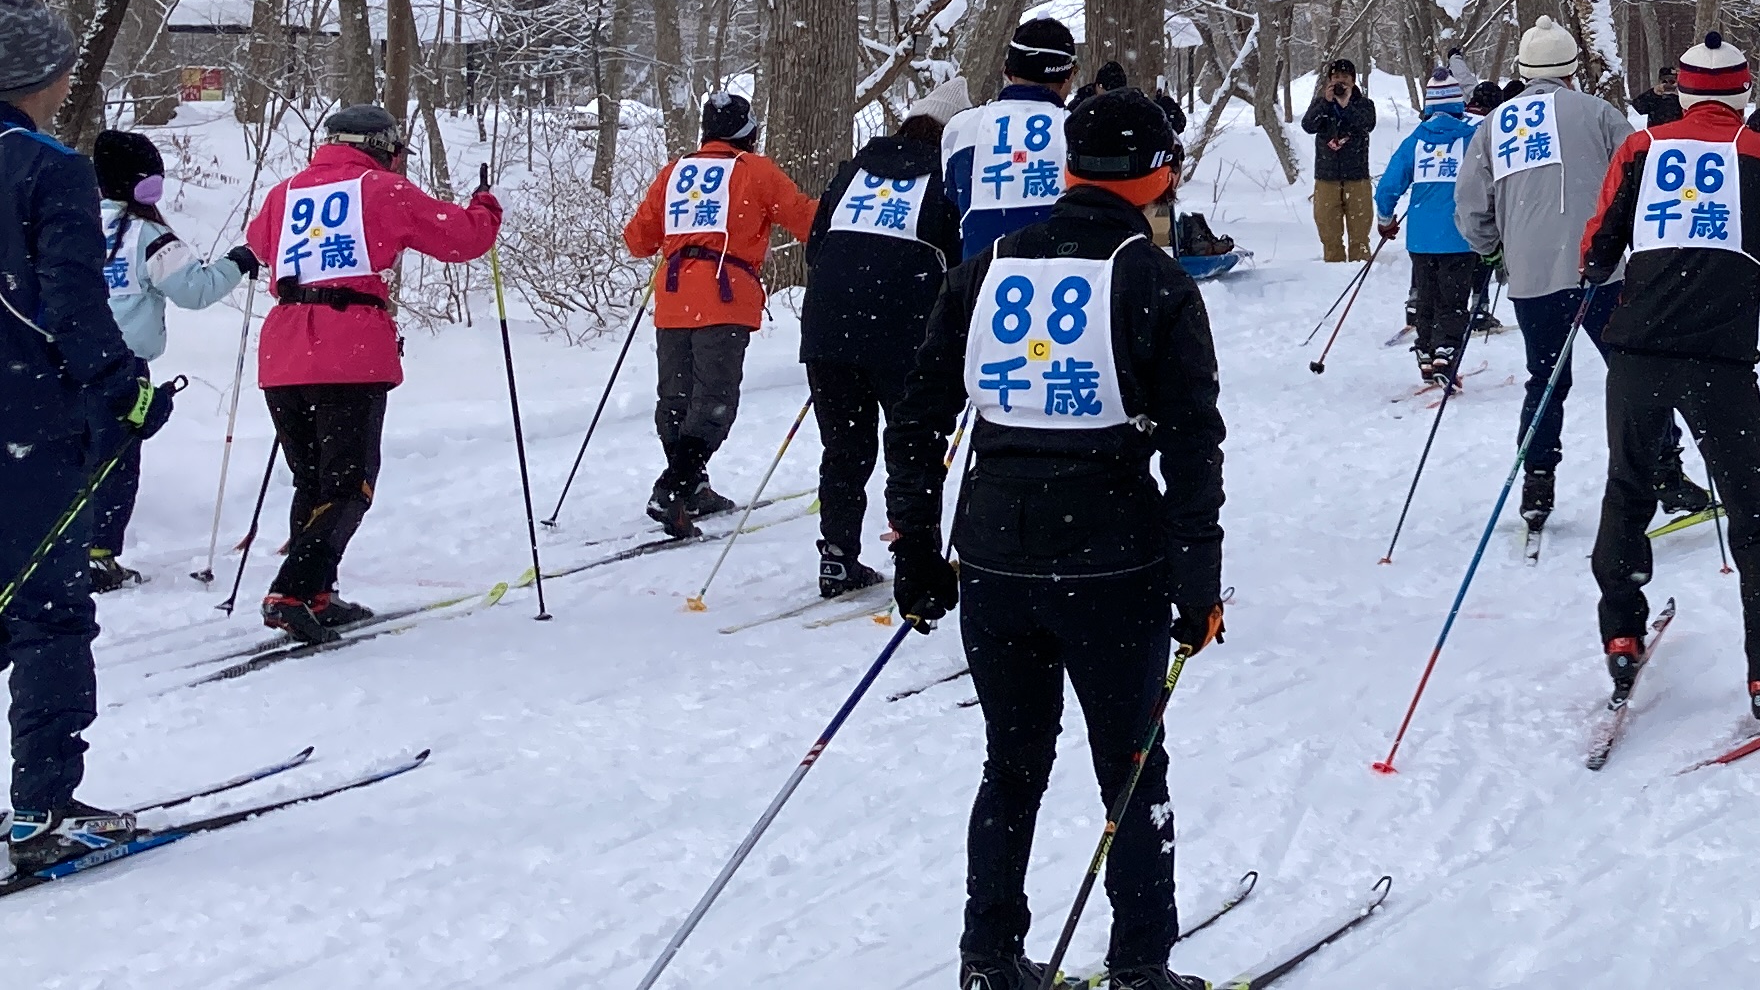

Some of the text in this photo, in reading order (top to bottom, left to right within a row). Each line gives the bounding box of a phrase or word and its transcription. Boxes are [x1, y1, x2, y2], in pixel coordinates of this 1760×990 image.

[992, 114, 1052, 155] 18
[1500, 101, 1545, 133] 63
[1418, 157, 1458, 178] 千歳
[1498, 132, 1551, 168] 千歳
[676, 164, 725, 194] 89
[981, 160, 1060, 200] 千歳
[1655, 148, 1726, 194] 66
[291, 191, 350, 235] 90
[669, 199, 721, 228] 千歳
[846, 194, 912, 231] 千歳
[1644, 199, 1730, 241] 千歳
[284, 234, 357, 281] 千歳
[992, 275, 1092, 345] 88
[1033, 342, 1045, 357] C
[979, 356, 1103, 417] 千歳
